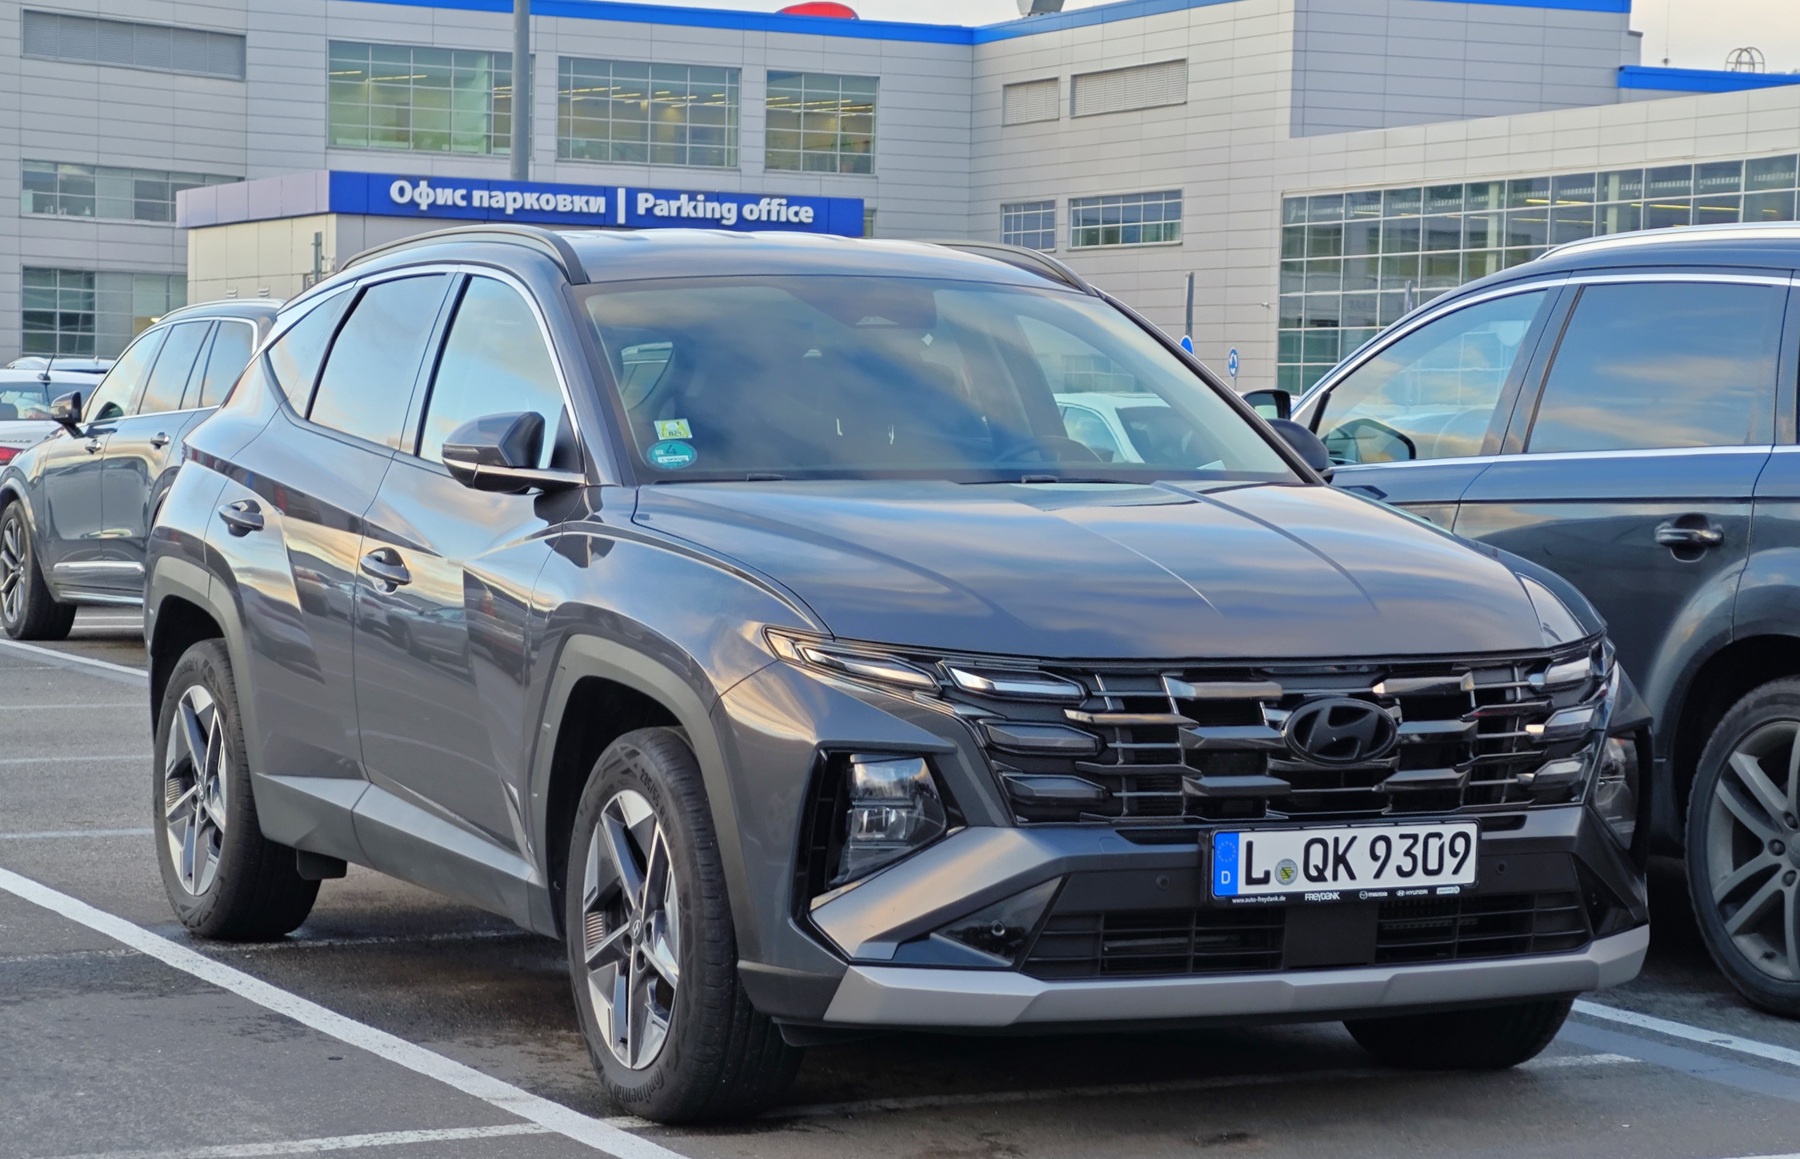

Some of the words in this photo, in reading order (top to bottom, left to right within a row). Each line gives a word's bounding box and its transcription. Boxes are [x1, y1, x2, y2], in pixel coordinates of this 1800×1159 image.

[390, 179, 467, 211] Офис
[472, 192, 606, 216] парковки
[636, 193, 738, 227] Parking
[742, 196, 815, 225] office
[665, 444, 678, 455] 4
[1245, 840, 1270, 885] L
[1303, 835, 1358, 883] QK
[1370, 831, 1471, 879] 9309
[1221, 871, 1231, 884] D
